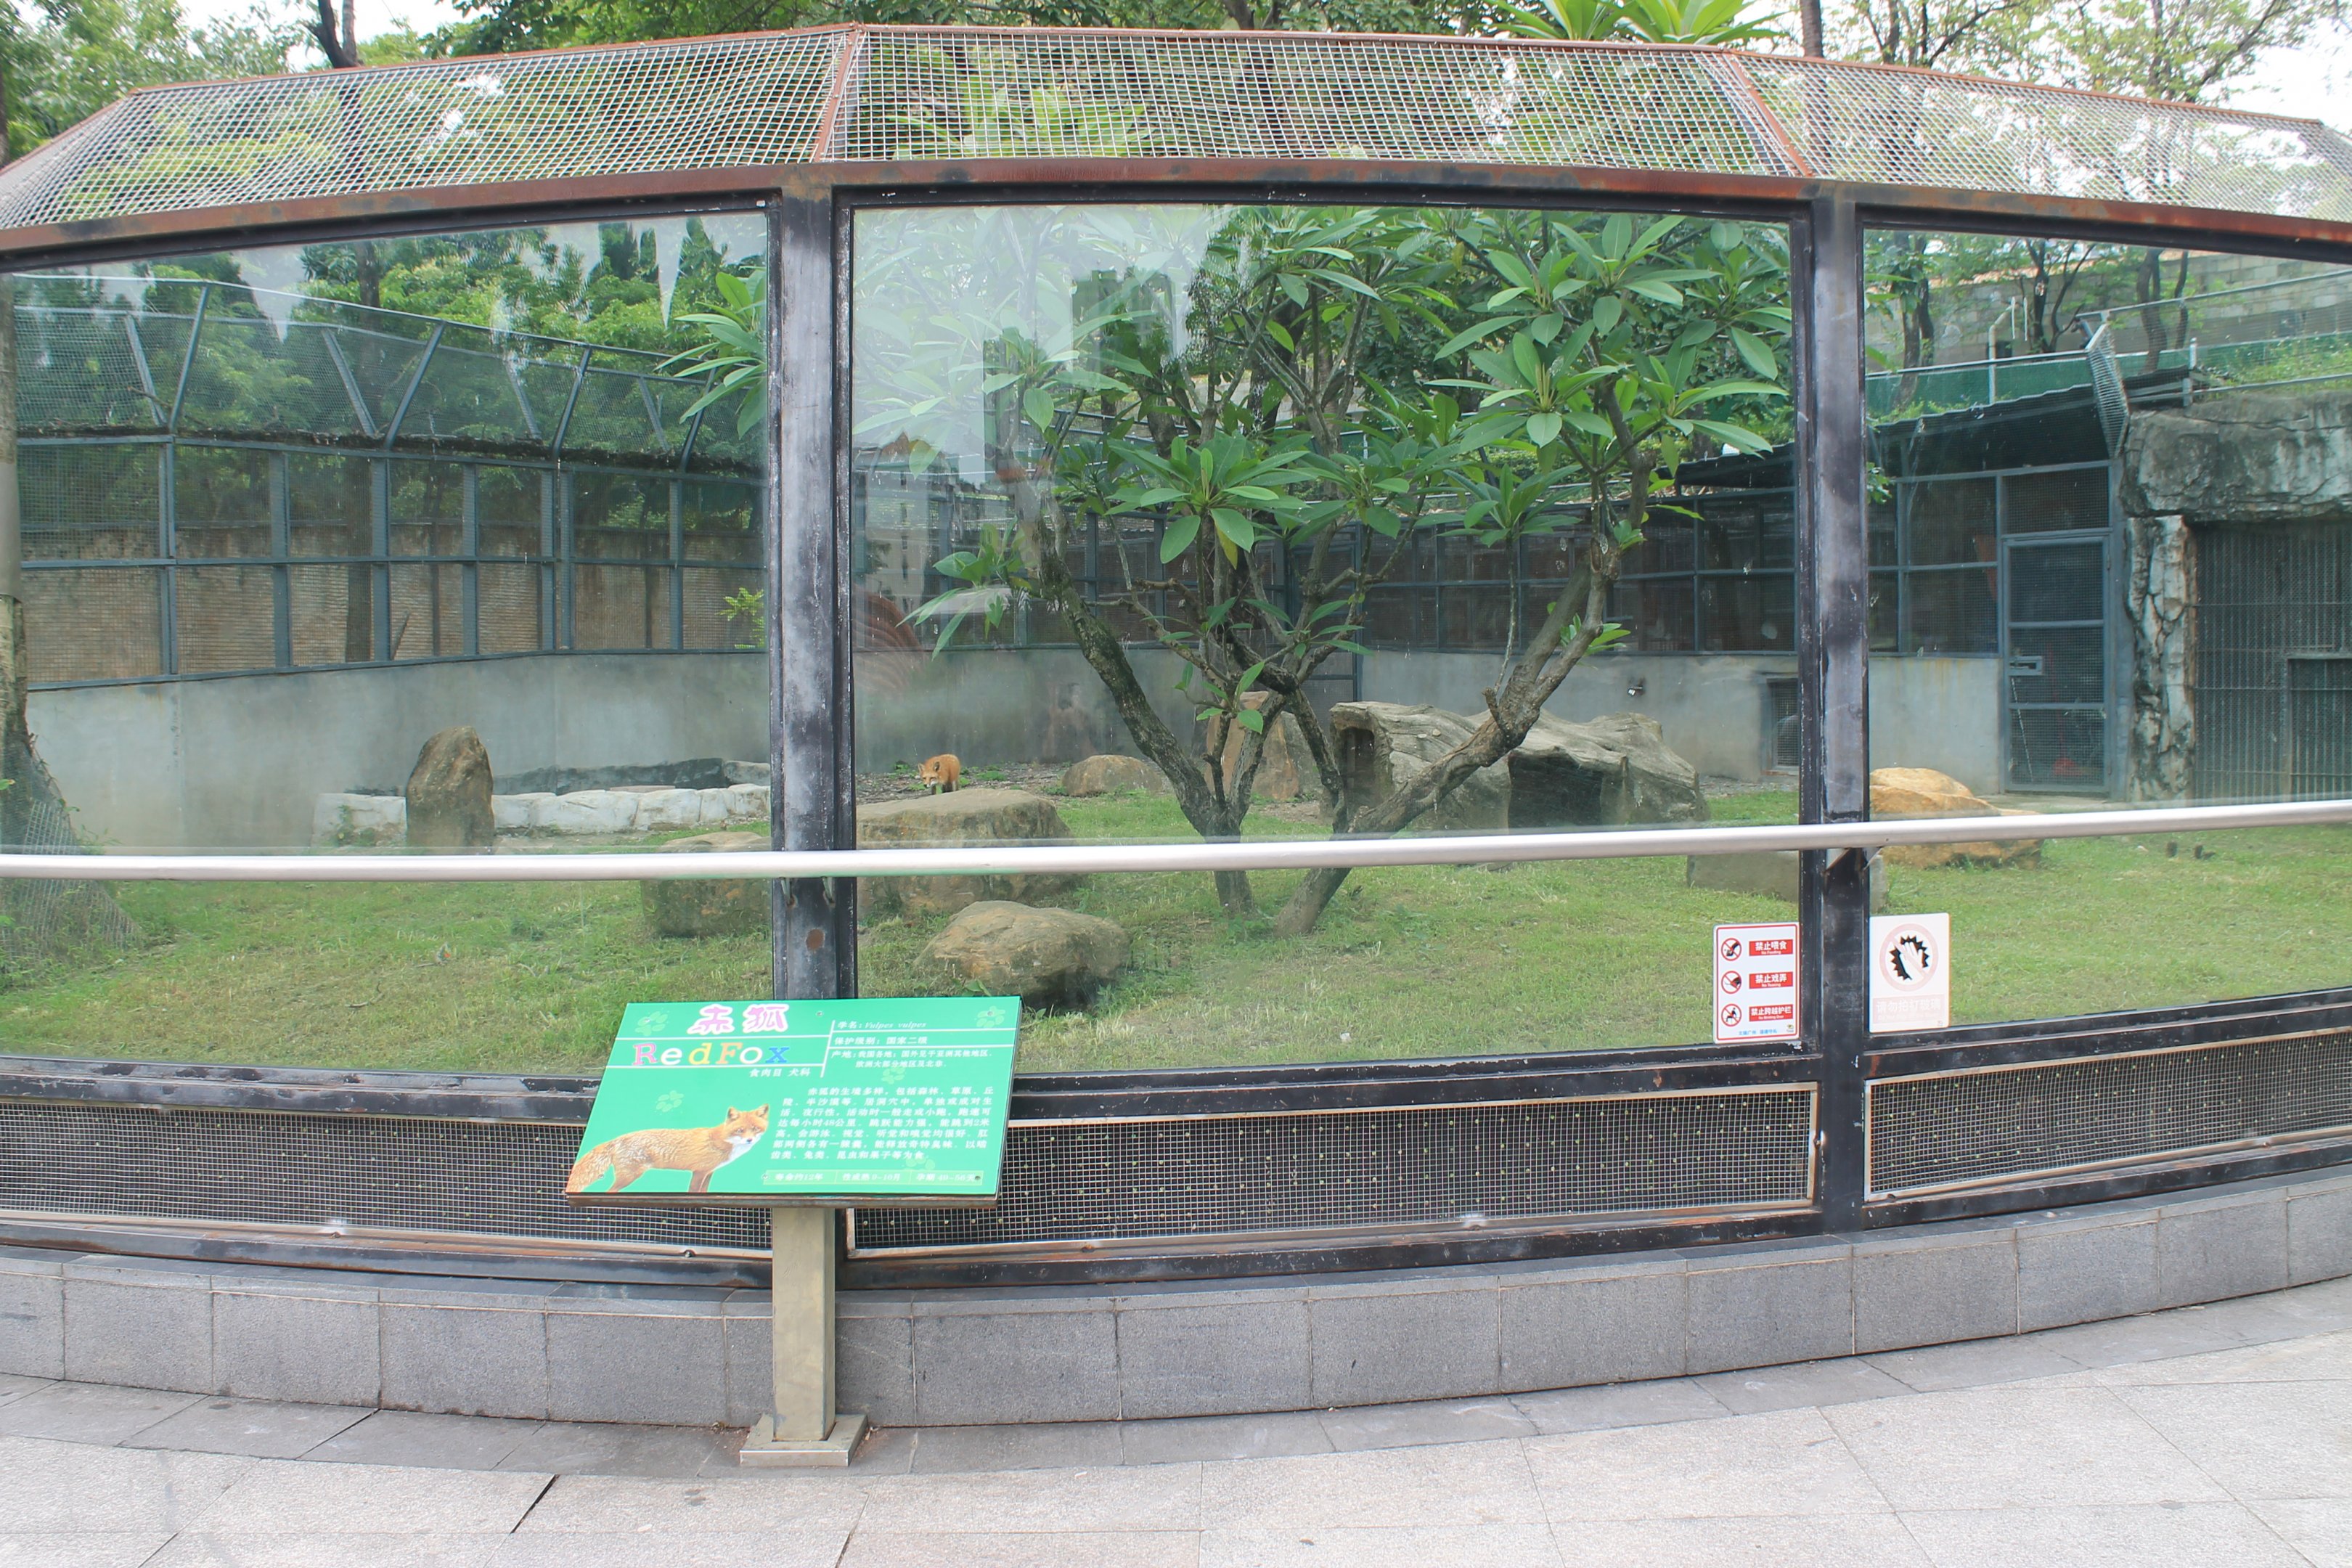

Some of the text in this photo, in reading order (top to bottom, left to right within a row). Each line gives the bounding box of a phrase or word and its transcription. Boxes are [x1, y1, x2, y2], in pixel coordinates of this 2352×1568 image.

[1755, 940, 1787, 951] 禁止喂食
[1755, 973, 1787, 984] 禁止戏弄
[1751, 1005, 1792, 1016] 禁止跨越护栏
[687, 1003, 790, 1034] 赤狐
[749, 1067, 811, 1077] 食肉目 犬科
[775, 1172, 824, 1182] 寿命约12年
